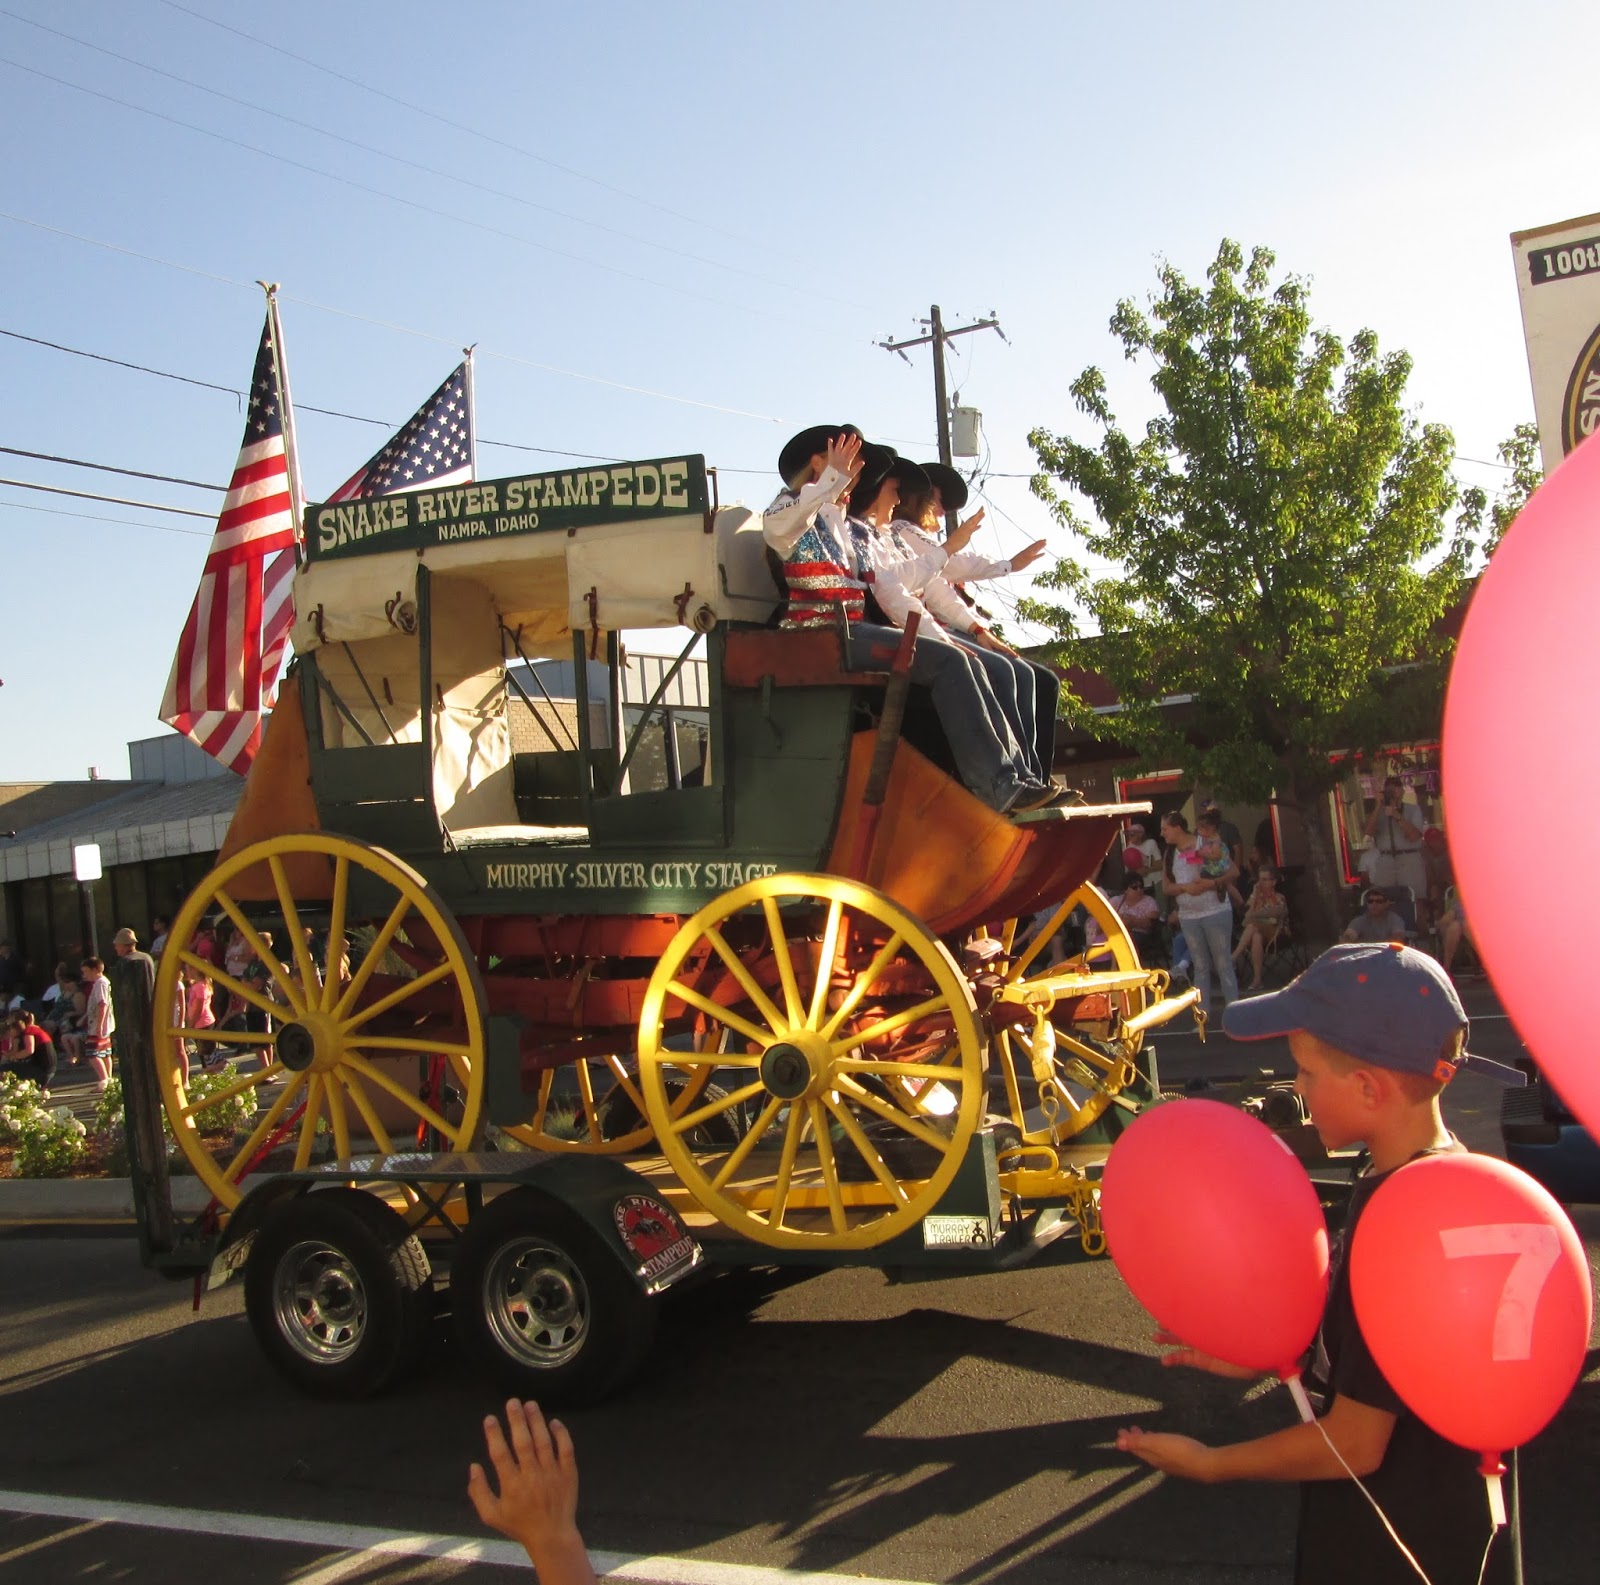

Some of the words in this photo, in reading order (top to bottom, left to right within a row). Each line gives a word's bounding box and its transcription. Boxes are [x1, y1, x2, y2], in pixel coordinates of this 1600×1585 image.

[318, 498, 409, 552] SNAKE
[417, 485, 500, 523] RIVER
[506, 461, 689, 511] STAMPEDE
[438, 520, 491, 541] NAMPA,
[495, 513, 539, 533] IDAHO
[651, 862, 701, 888] CITY
[930, 1223, 970, 1235] MURRAY
[933, 1234, 971, 1245] TRAILER
[643, 1235, 696, 1278] STAMPEDE
[1439, 1222, 1562, 1362] 7
